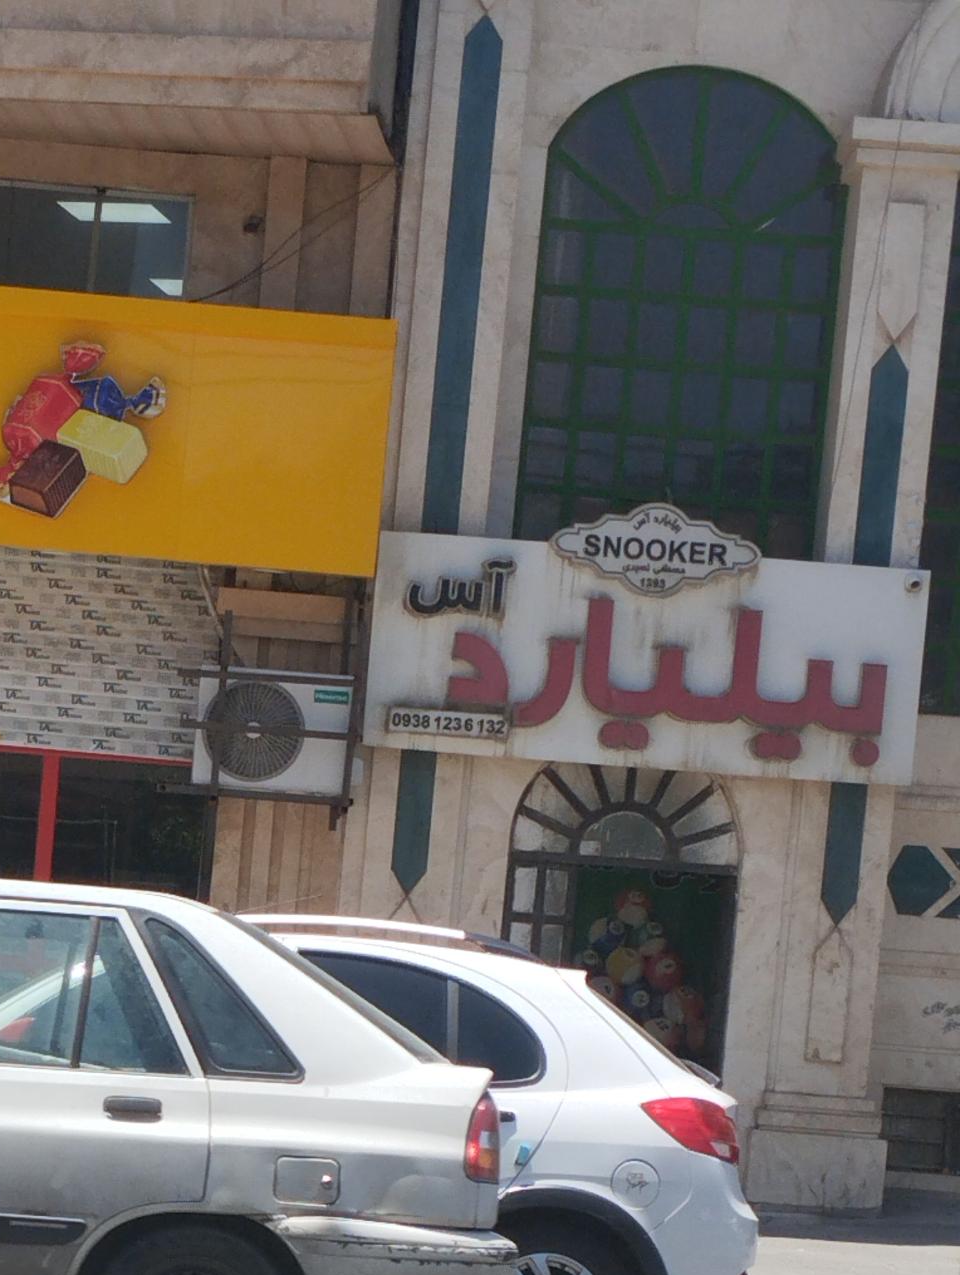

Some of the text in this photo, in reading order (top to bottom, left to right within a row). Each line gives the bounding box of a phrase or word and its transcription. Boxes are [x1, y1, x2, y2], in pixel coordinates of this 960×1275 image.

[583, 534, 728, 567] SNOOKER
[403, 556, 517, 619] آس
[445, 592, 888, 768] بیلیارد
